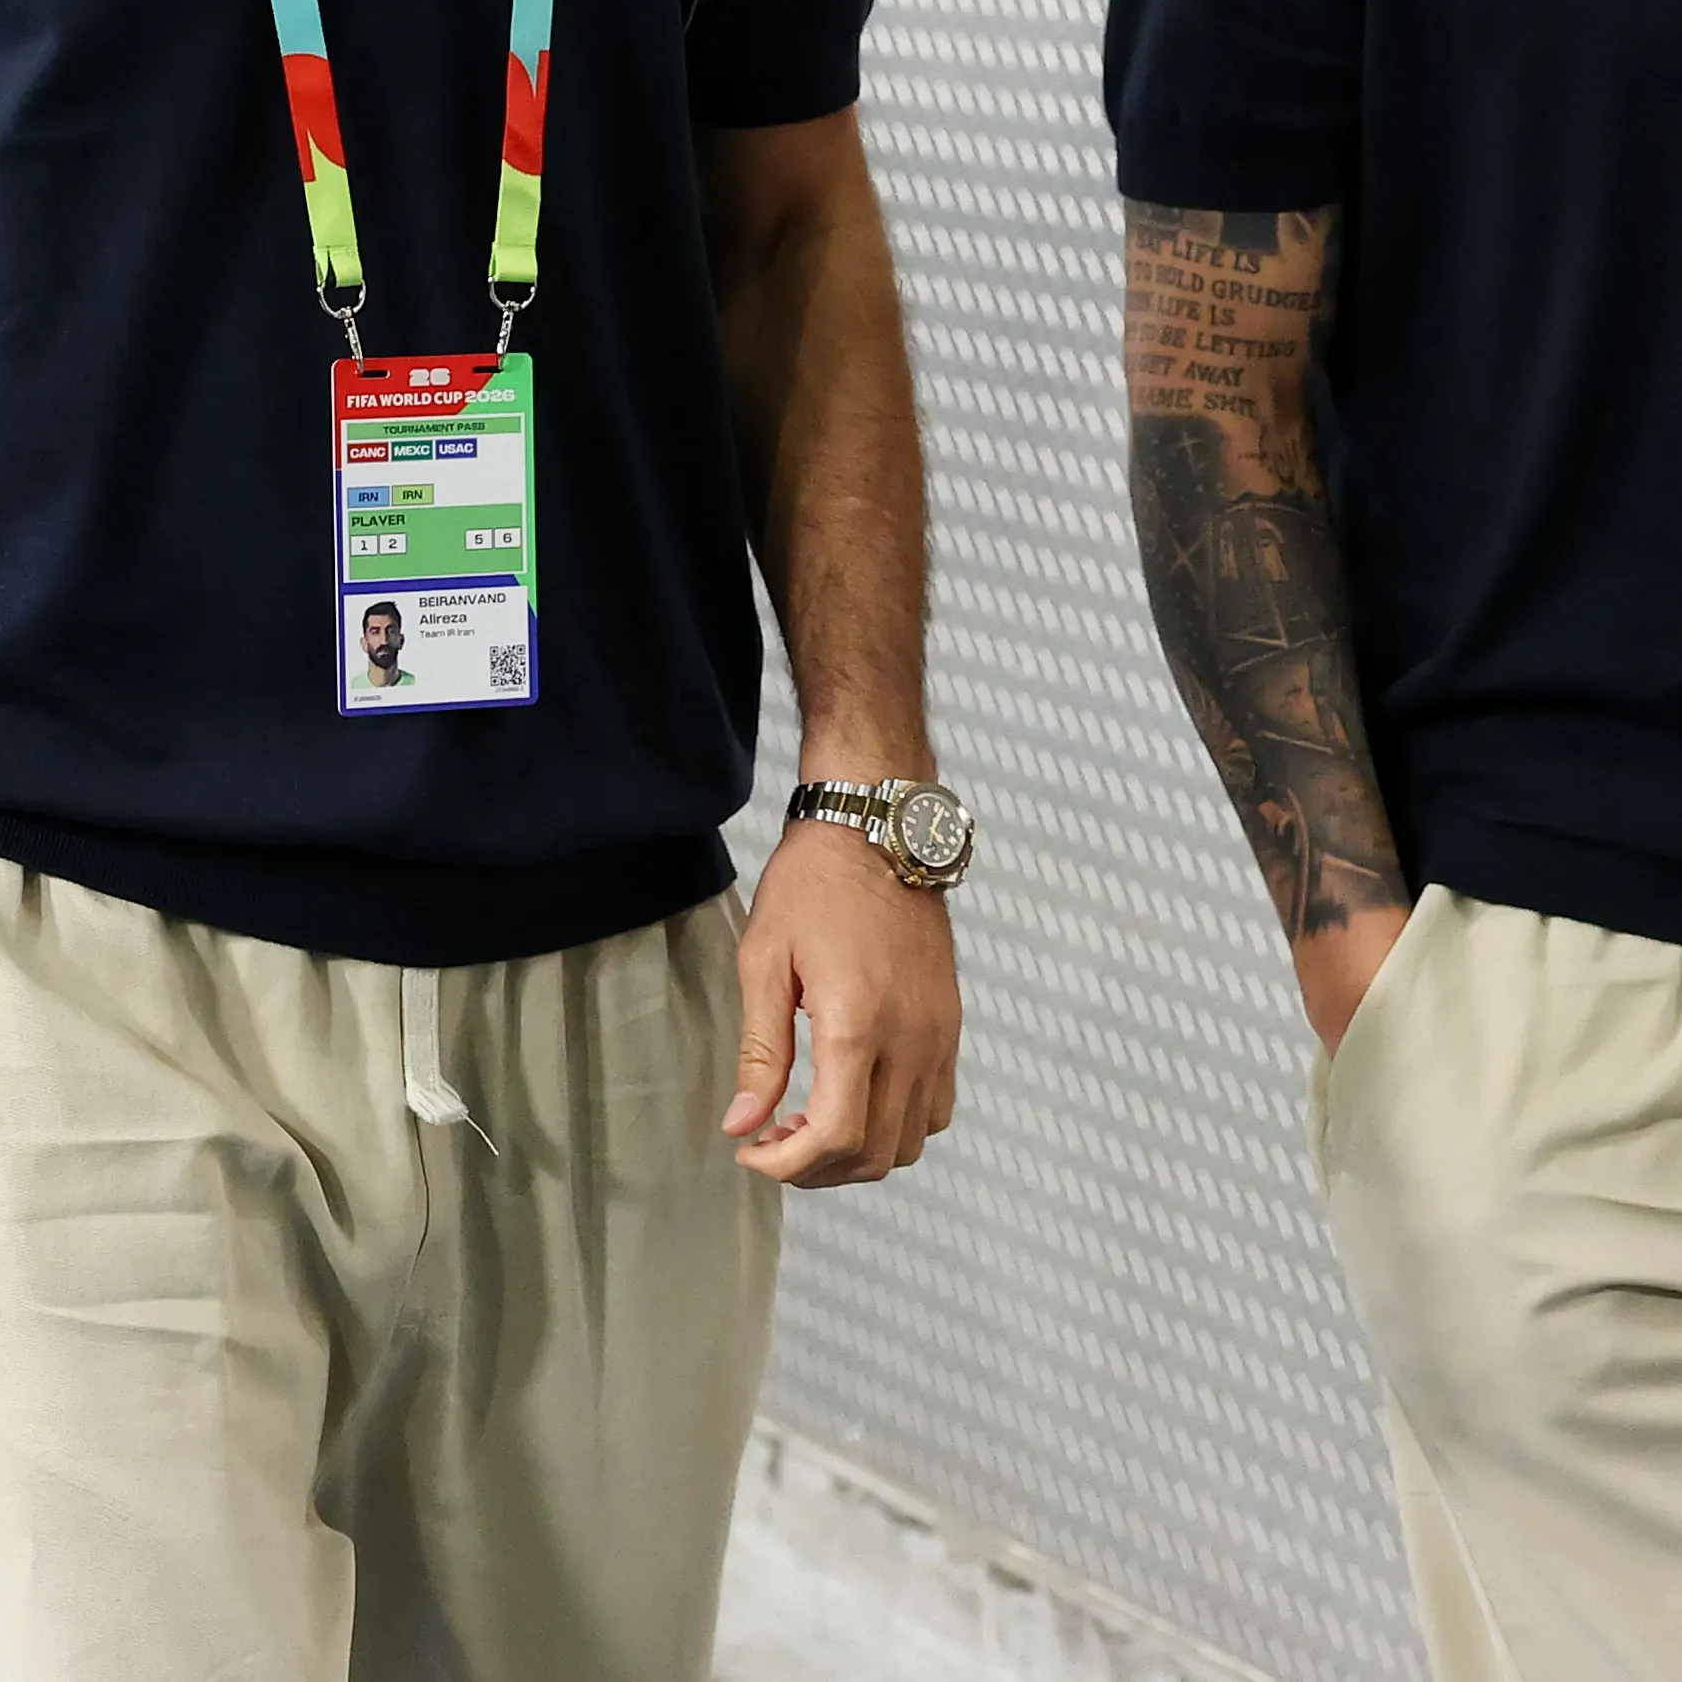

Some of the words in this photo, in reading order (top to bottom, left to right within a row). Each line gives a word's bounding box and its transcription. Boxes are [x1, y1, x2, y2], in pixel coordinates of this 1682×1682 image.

[347, 395, 378, 408] FIFA
[379, 393, 432, 406] WORLD
[433, 391, 463, 404] CUP
[464, 389, 515, 403] 2026
[383, 423, 455, 435] TOURNAMENT
[350, 446, 386, 459] CANC
[394, 443, 430, 456] MEXC
[439, 443, 473, 455] USAC
[358, 492, 378, 502] IRN
[402, 490, 423, 500] IRN
[419, 593, 506, 608] BEIRANVAND
[419, 613, 468, 625] Alireza
